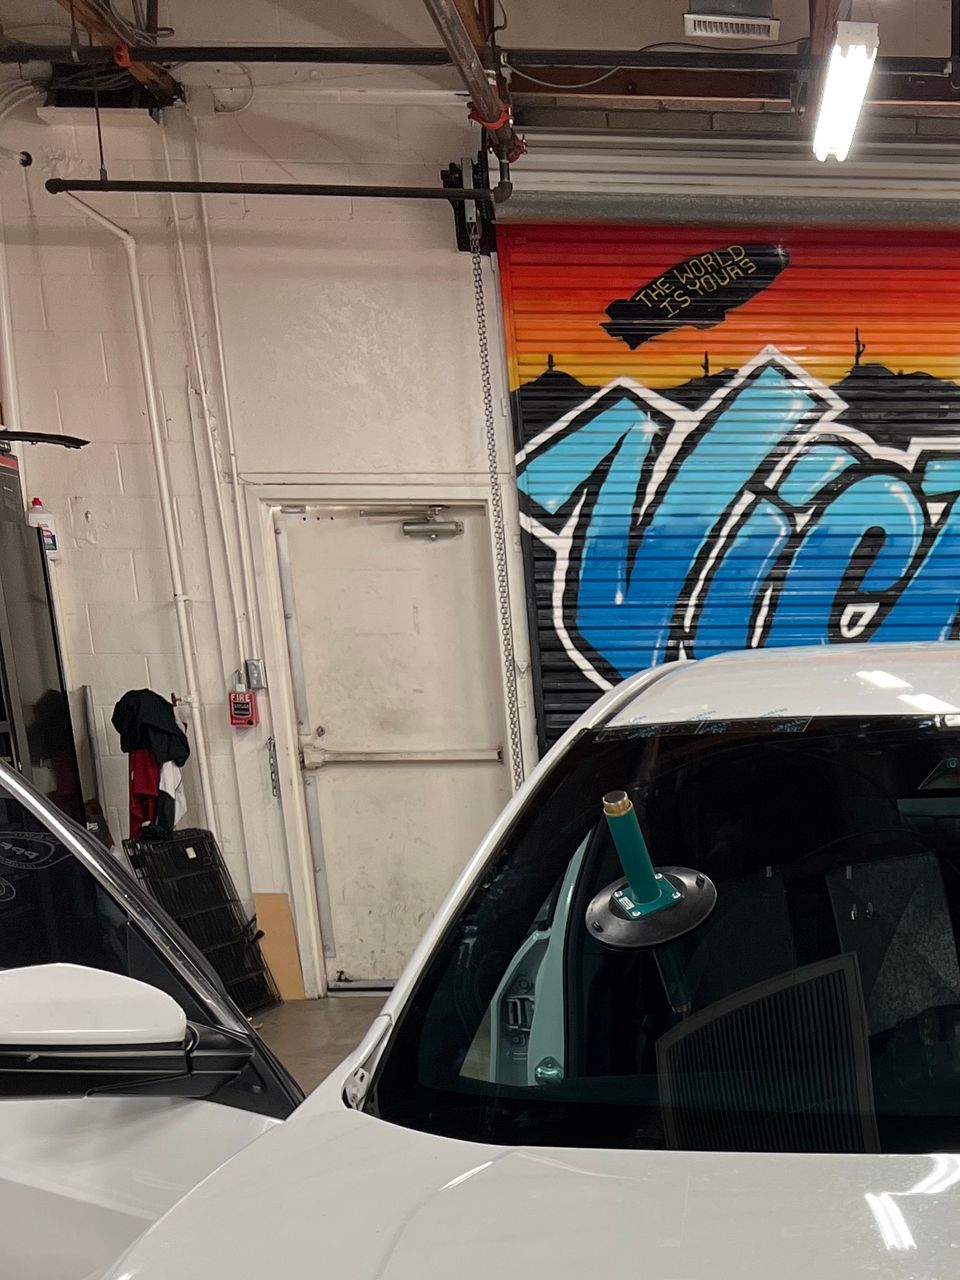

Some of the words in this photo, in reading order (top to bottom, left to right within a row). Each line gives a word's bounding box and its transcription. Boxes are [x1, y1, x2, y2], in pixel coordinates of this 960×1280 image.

[635, 277, 675, 308] THE
[673, 244, 746, 285] WORLD
[659, 290, 692, 318] IS
[687, 258, 758, 296] YOURS
[231, 693, 251, 702] FIRE
